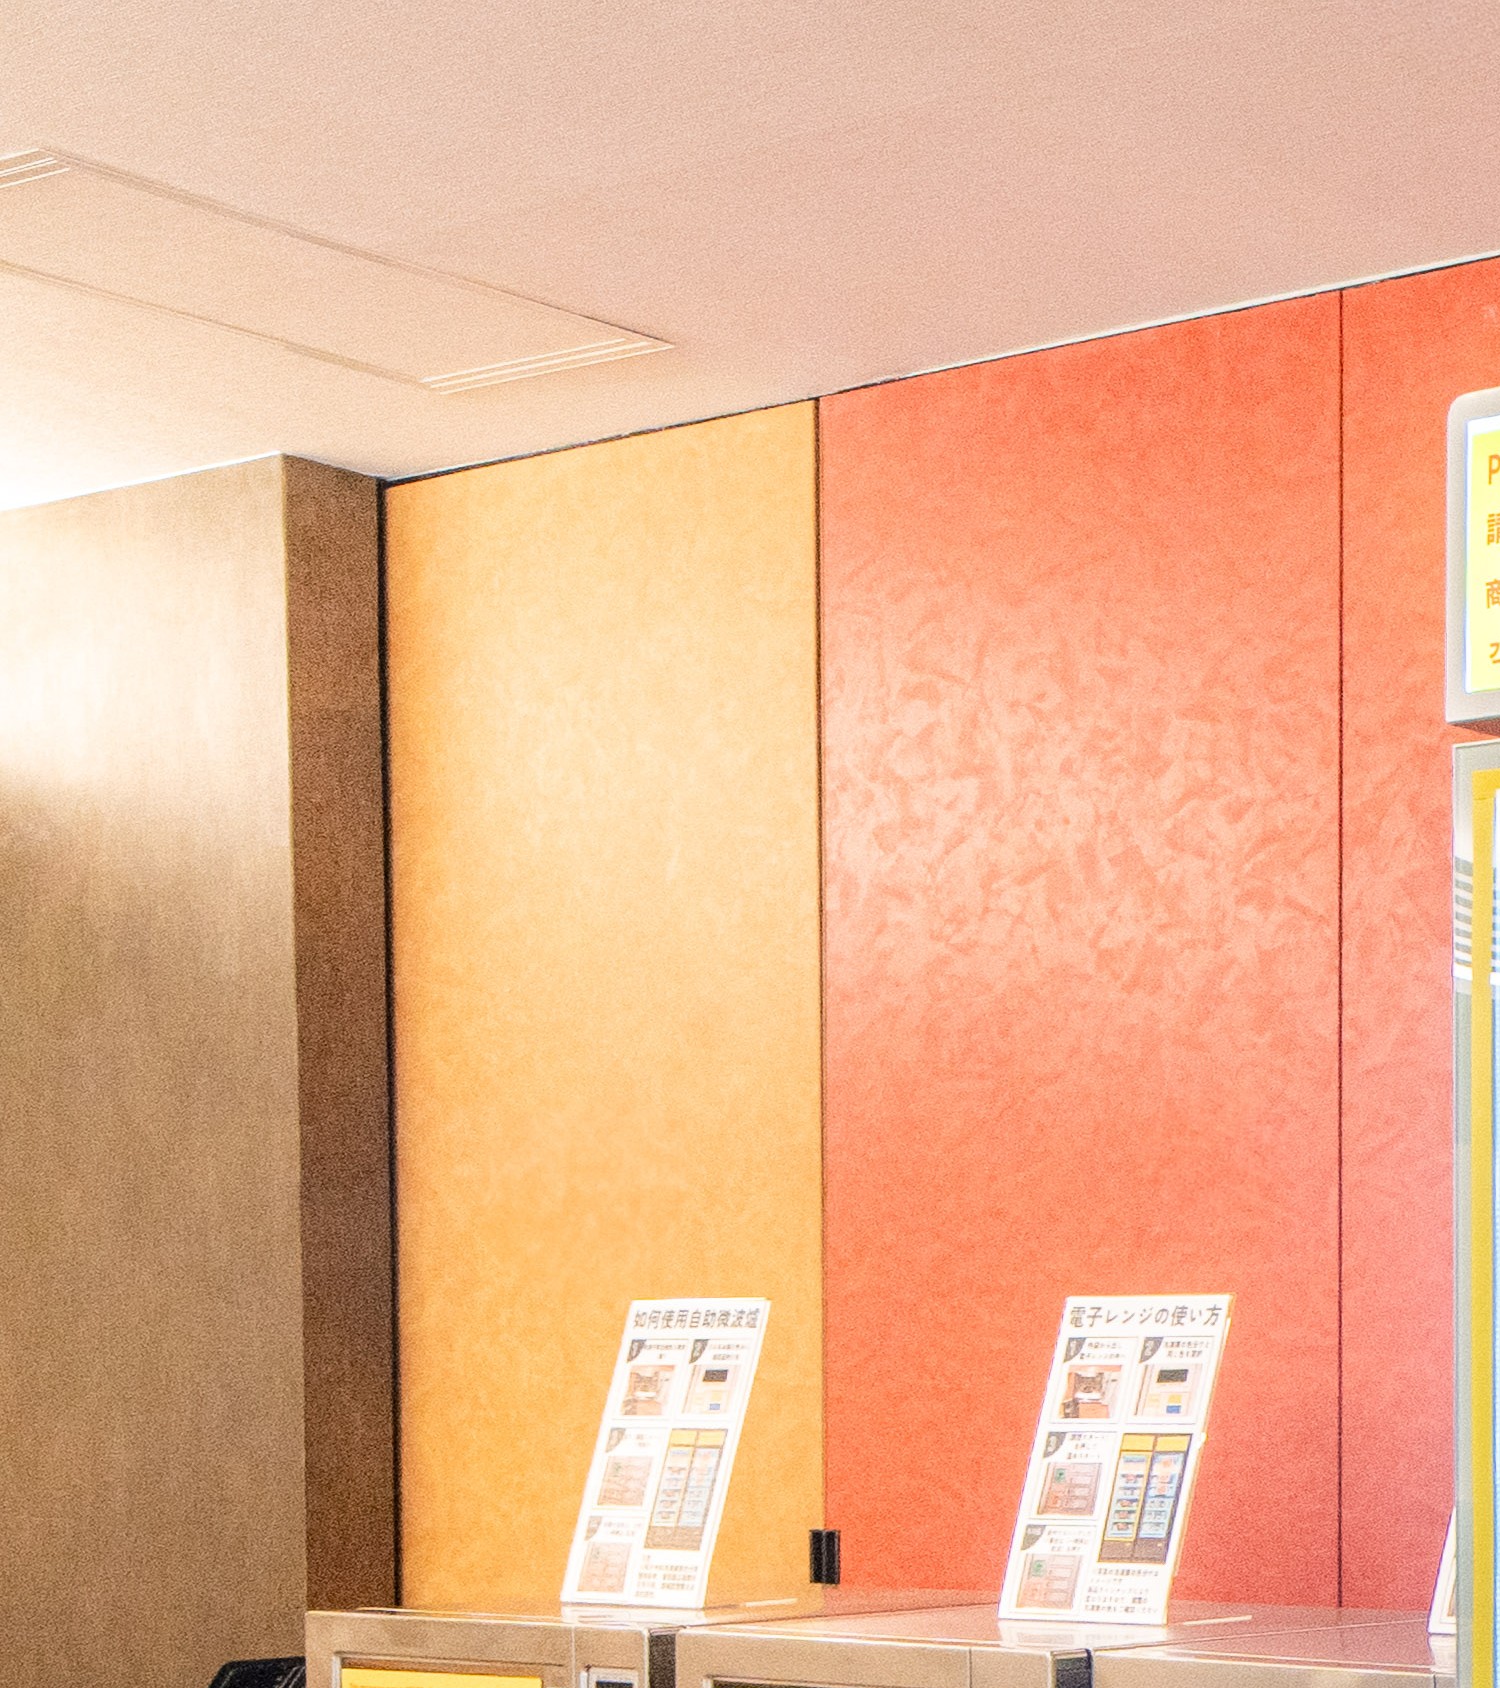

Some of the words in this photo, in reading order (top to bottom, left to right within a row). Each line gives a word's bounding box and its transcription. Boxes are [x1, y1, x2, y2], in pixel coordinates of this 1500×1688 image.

[1070, 1305, 1223, 1328] 電子レンジの使い方
